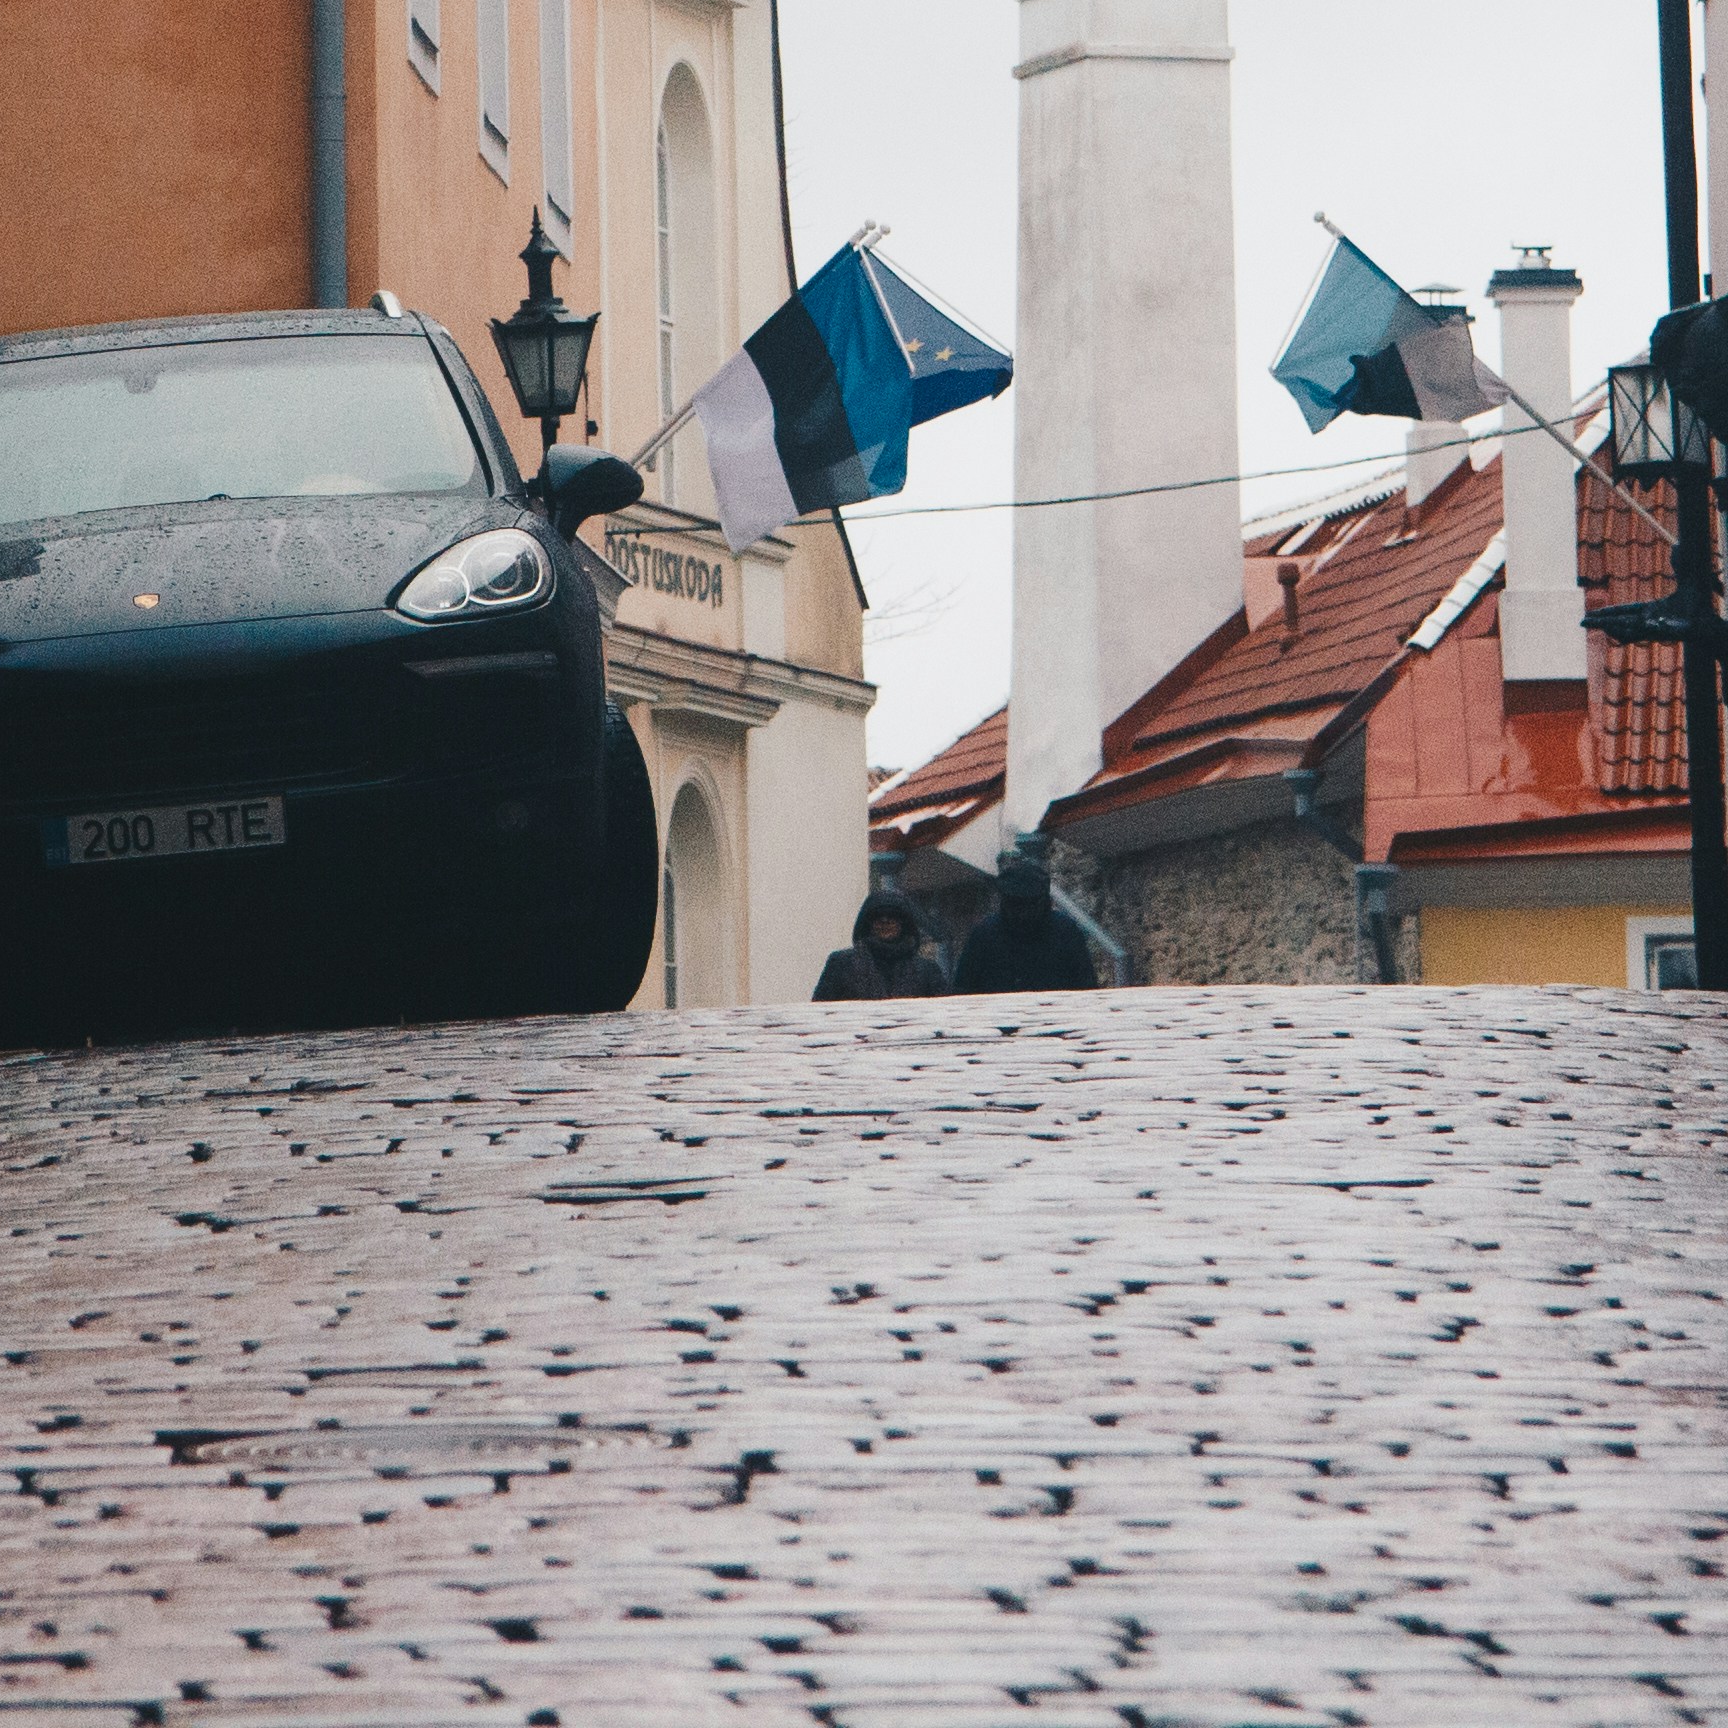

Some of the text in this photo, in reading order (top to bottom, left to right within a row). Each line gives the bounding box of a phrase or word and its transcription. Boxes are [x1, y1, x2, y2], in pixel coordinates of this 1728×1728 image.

[82, 801, 272, 860] 200 RTE
[45, 846, 68, 861] EST
